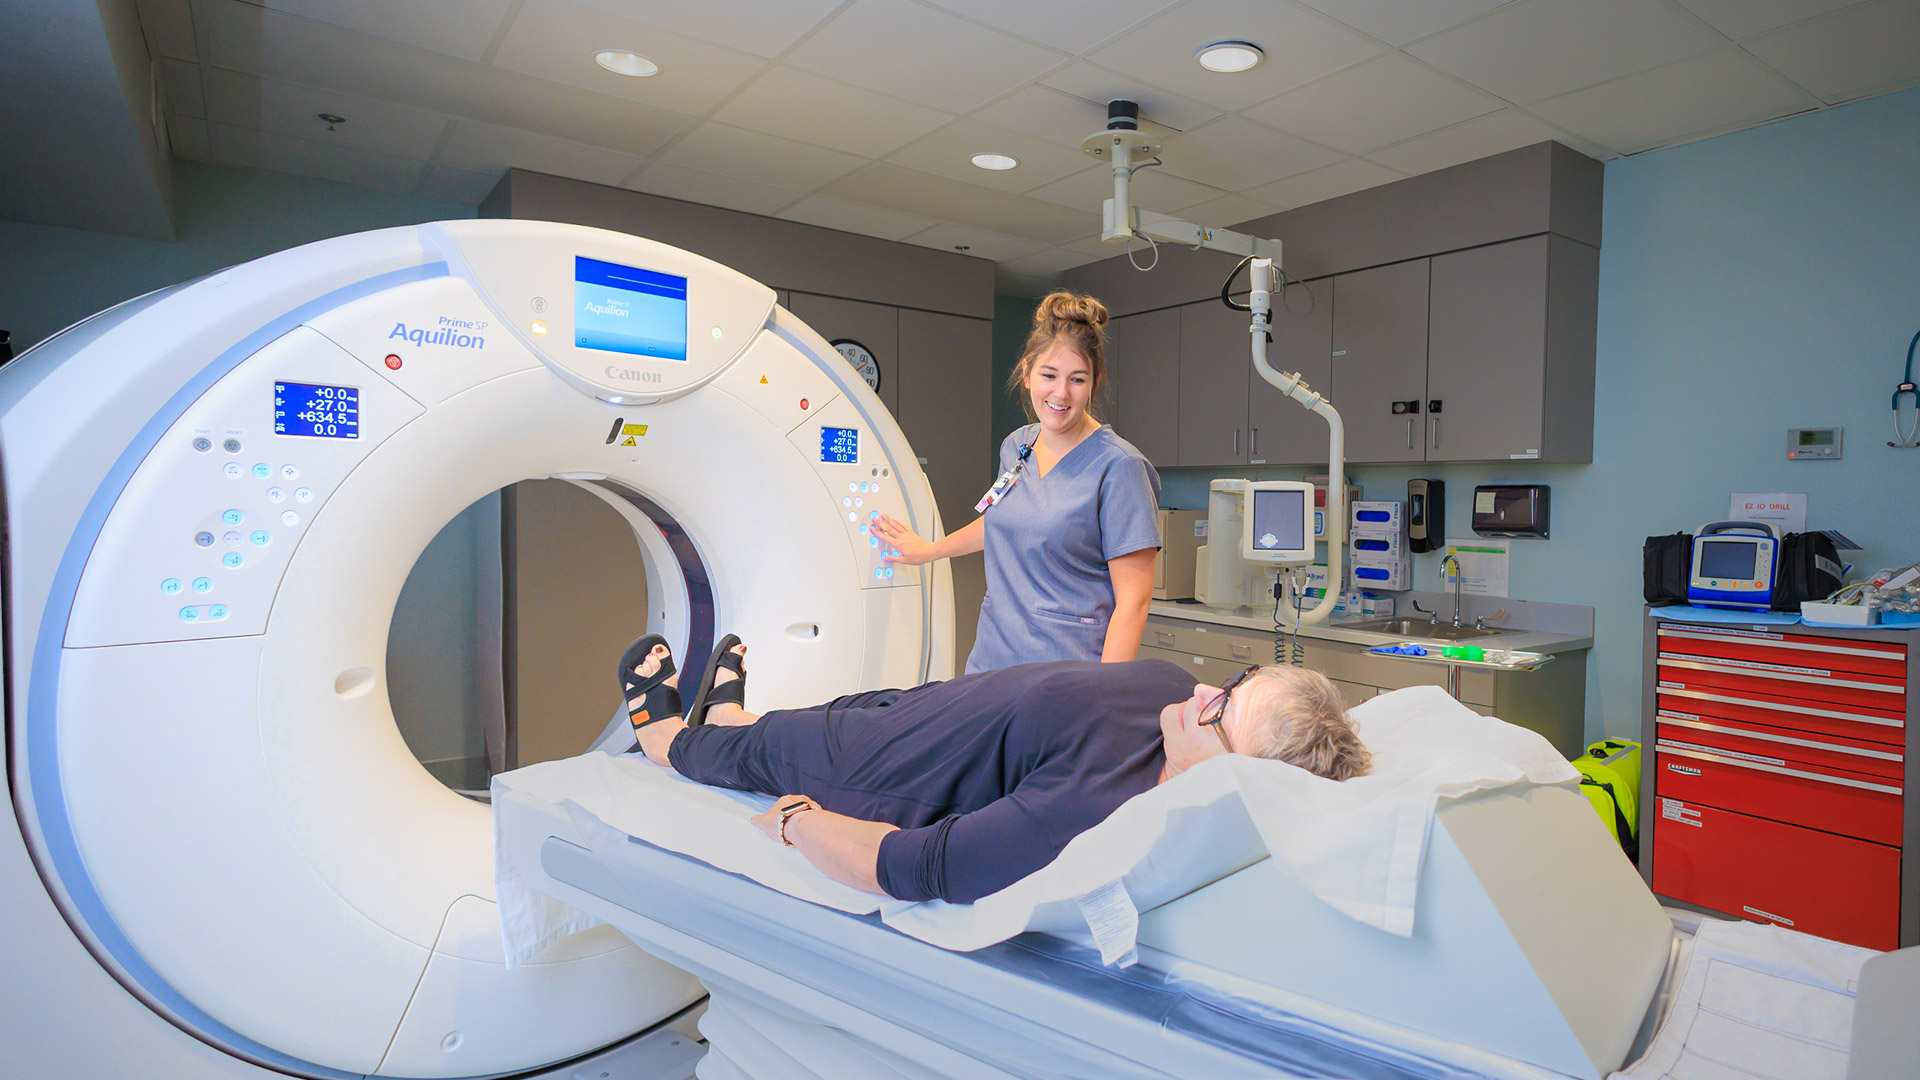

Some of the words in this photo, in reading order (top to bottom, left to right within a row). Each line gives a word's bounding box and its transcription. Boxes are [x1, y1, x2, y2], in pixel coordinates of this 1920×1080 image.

[607, 298, 624, 306] Prime
[584, 302, 629, 318] Aquilion
[438, 316, 474, 329] Prime
[475, 321, 488, 330] SP
[388, 322, 485, 349] Aquilion
[847, 348, 856, 357] 40
[860, 353, 869, 363] 60
[605, 366, 662, 384] Canon
[866, 366, 875, 375] 80
[315, 388, 347, 400] +0.0
[306, 399, 347, 412] +27.0
[297, 411, 347, 424] +634.5
[314, 424, 337, 435] 0.0
[838, 429, 852, 438] +0.0
[833, 437, 852, 446] +27.0
[830, 445, 852, 454] +634.5
[836, 453, 848, 462] 0.0
[1769, 503, 1791, 511] DRILL
[1668, 763, 1702, 773] CRAFTSMAN
